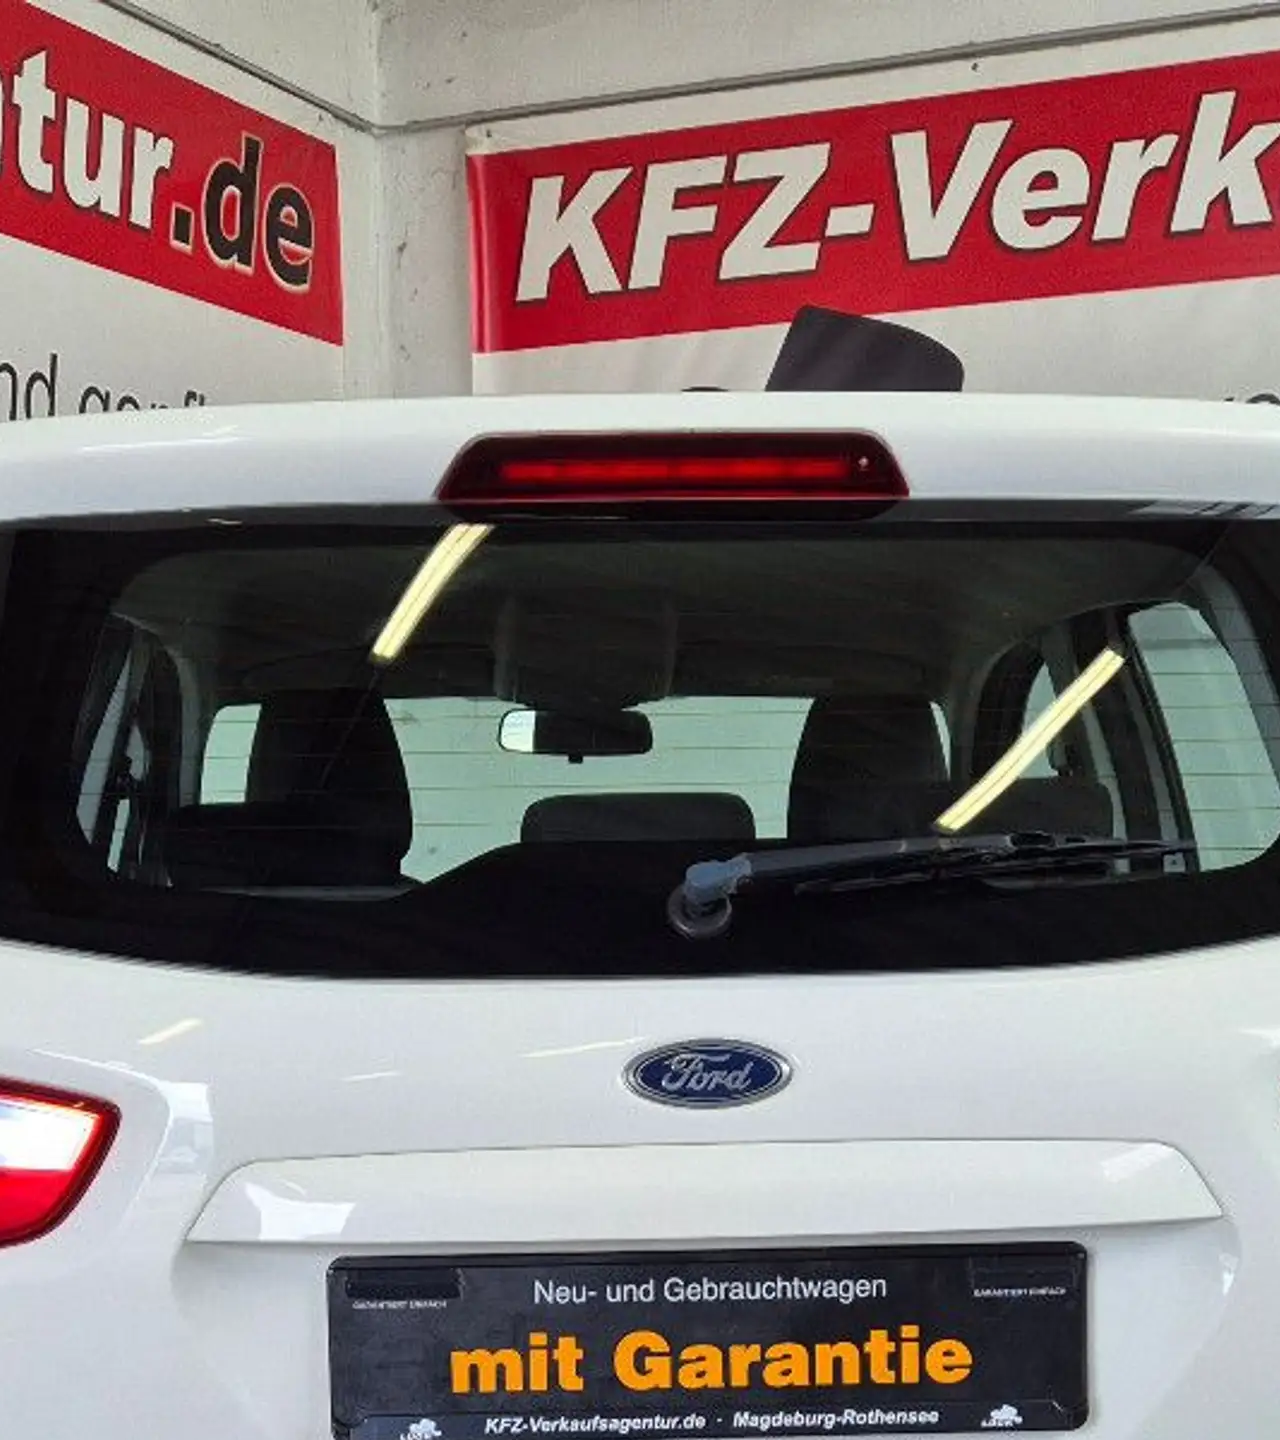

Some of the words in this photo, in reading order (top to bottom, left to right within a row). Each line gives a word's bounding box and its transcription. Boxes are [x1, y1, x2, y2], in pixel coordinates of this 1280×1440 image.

[661, 1053, 755, 1092] Ford
[534, 1278, 597, 1304] Neu-
[606, 1279, 657, 1302] und
[664, 1276, 887, 1304] Gebrauchtwagen
[450, 1331, 585, 1394] mit
[612, 1324, 974, 1391] Garantie
[485, 1413, 707, 1435] KFZ-Verkaufsagentur.de
[733, 1408, 940, 1431] Magdeburg-Rothensee
